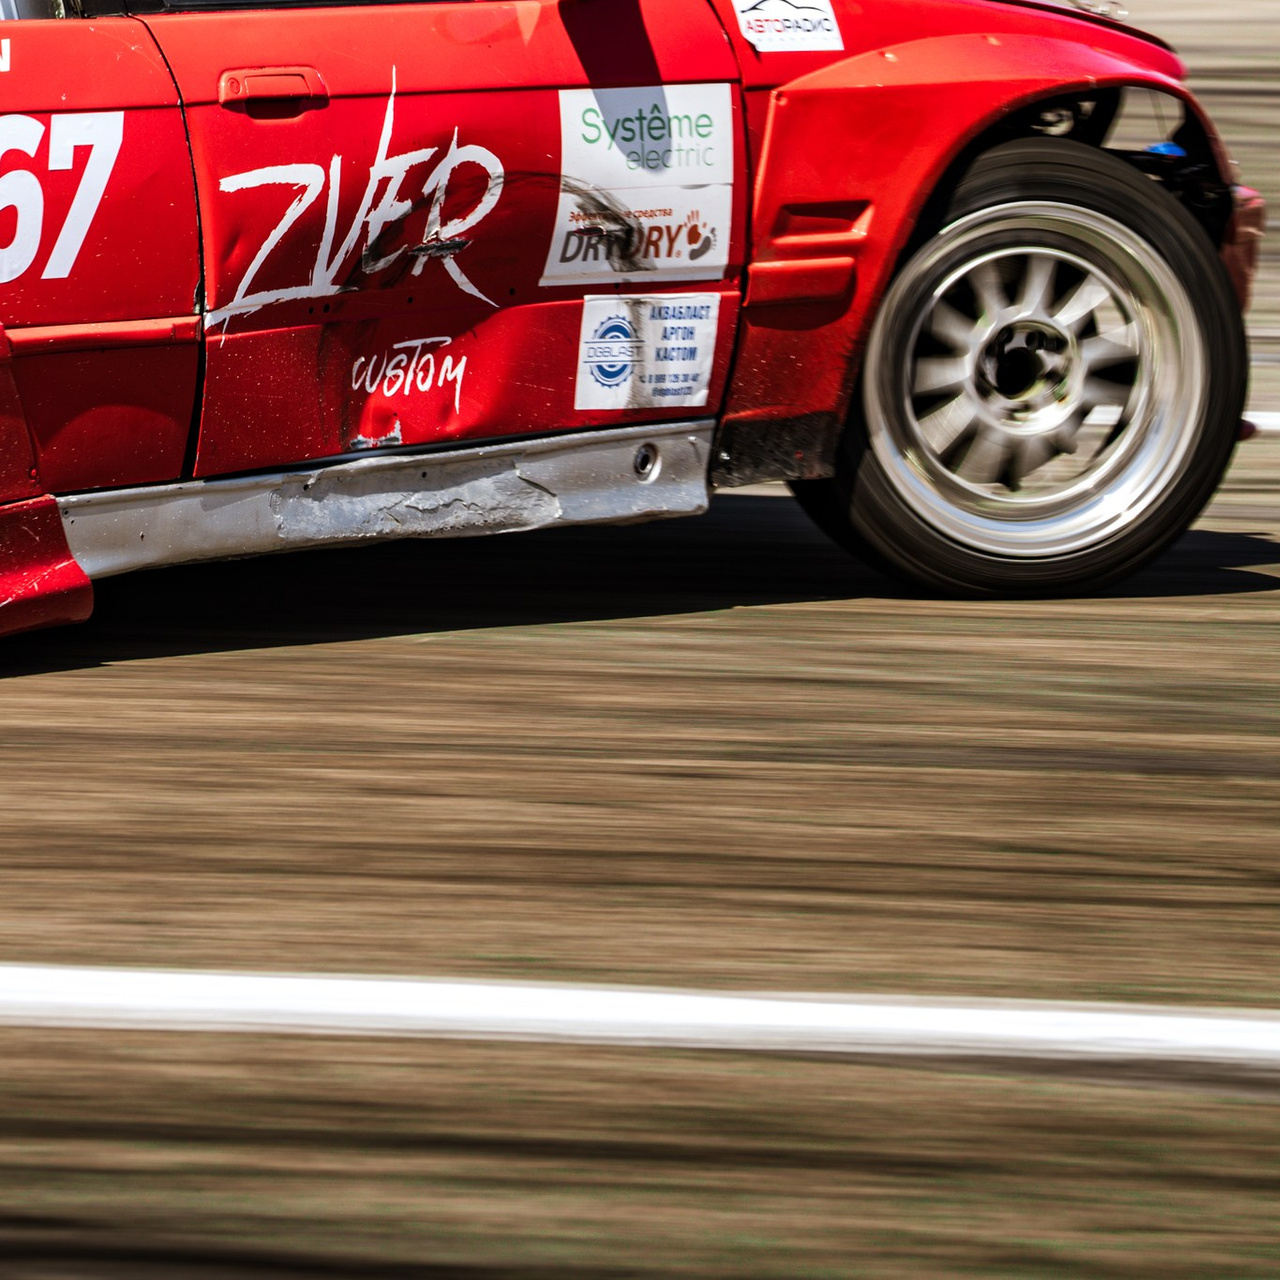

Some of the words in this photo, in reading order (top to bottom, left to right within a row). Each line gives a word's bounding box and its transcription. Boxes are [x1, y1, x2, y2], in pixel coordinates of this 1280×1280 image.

[581, 103, 714, 151] Système
[626, 142, 715, 170] electric
[203, 64, 505, 347] ZVER
[649, 305, 711, 320] АКВАБЛАСТ
[661, 326, 696, 341] АРГОН
[655, 346, 698, 361] КАСТОМ
